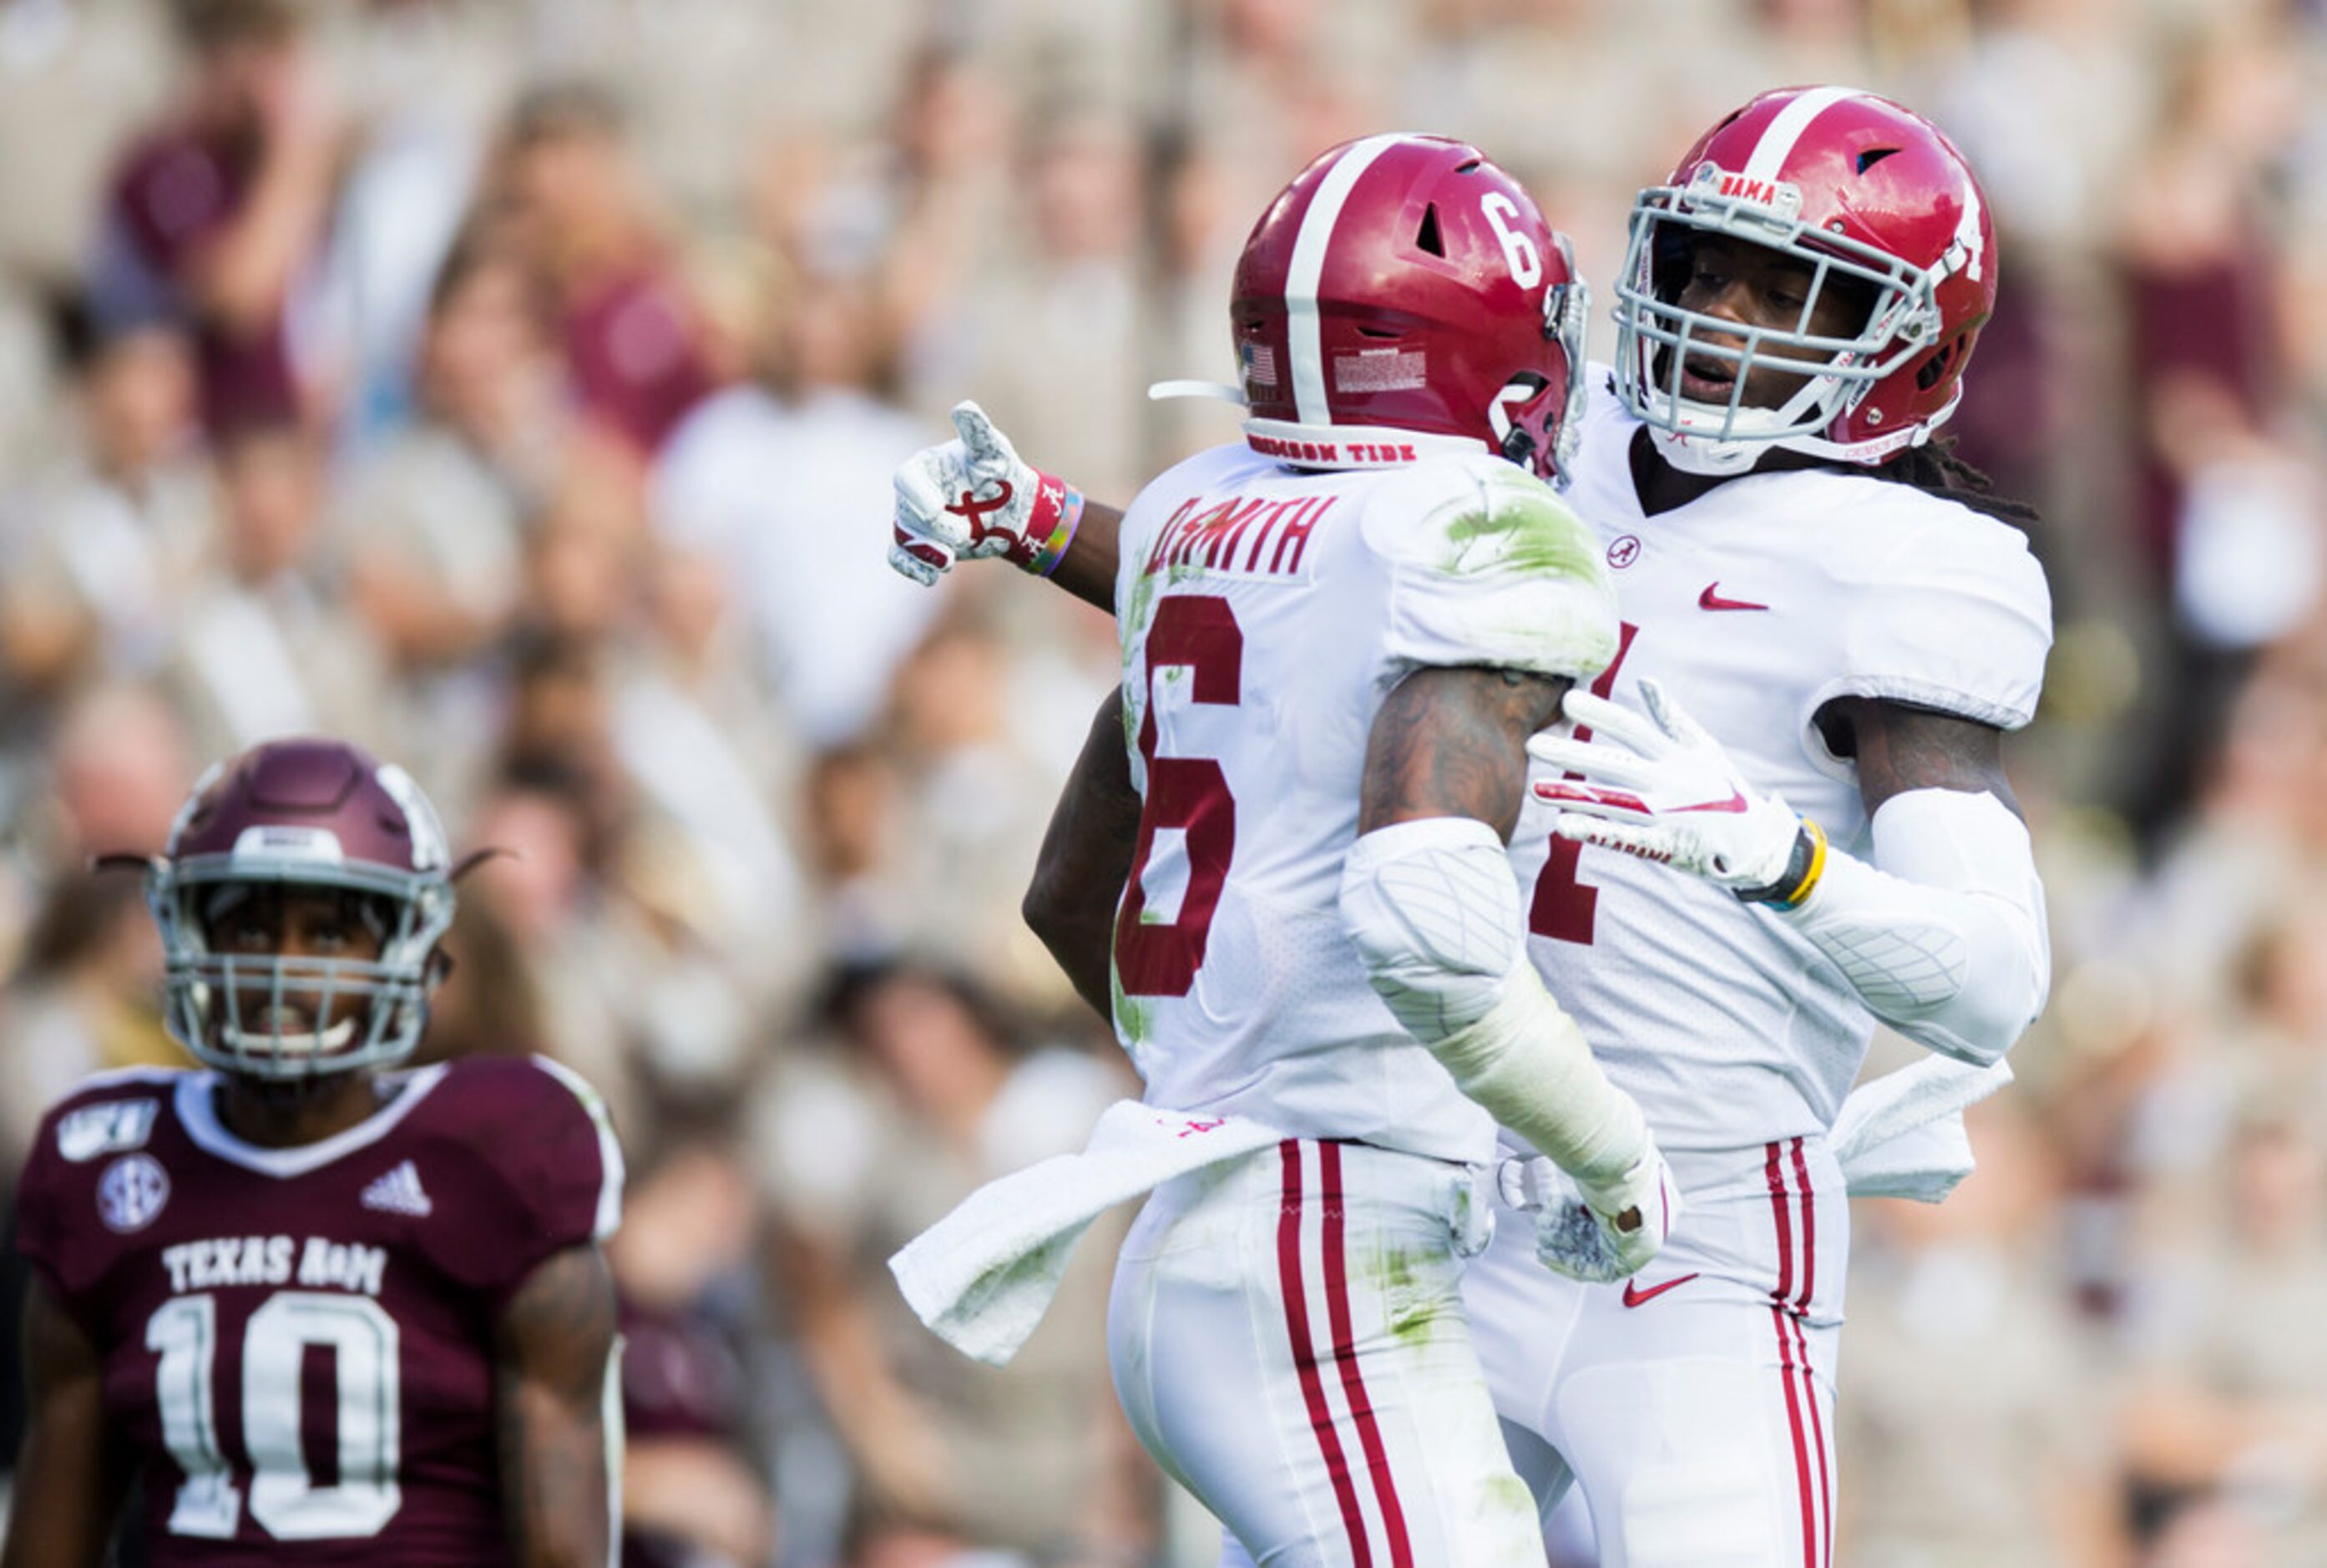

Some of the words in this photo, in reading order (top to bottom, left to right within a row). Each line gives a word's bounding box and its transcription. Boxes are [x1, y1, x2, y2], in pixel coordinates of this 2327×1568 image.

[1719, 175, 1776, 205] BAMA
[1480, 191, 1543, 290] 6
[1346, 443, 1417, 462] TIDE
[1112, 594, 1244, 998] 6
[162, 1235, 294, 1293] TEXAS
[297, 1237, 387, 1295] A&M
[144, 1291, 402, 1542] 10
